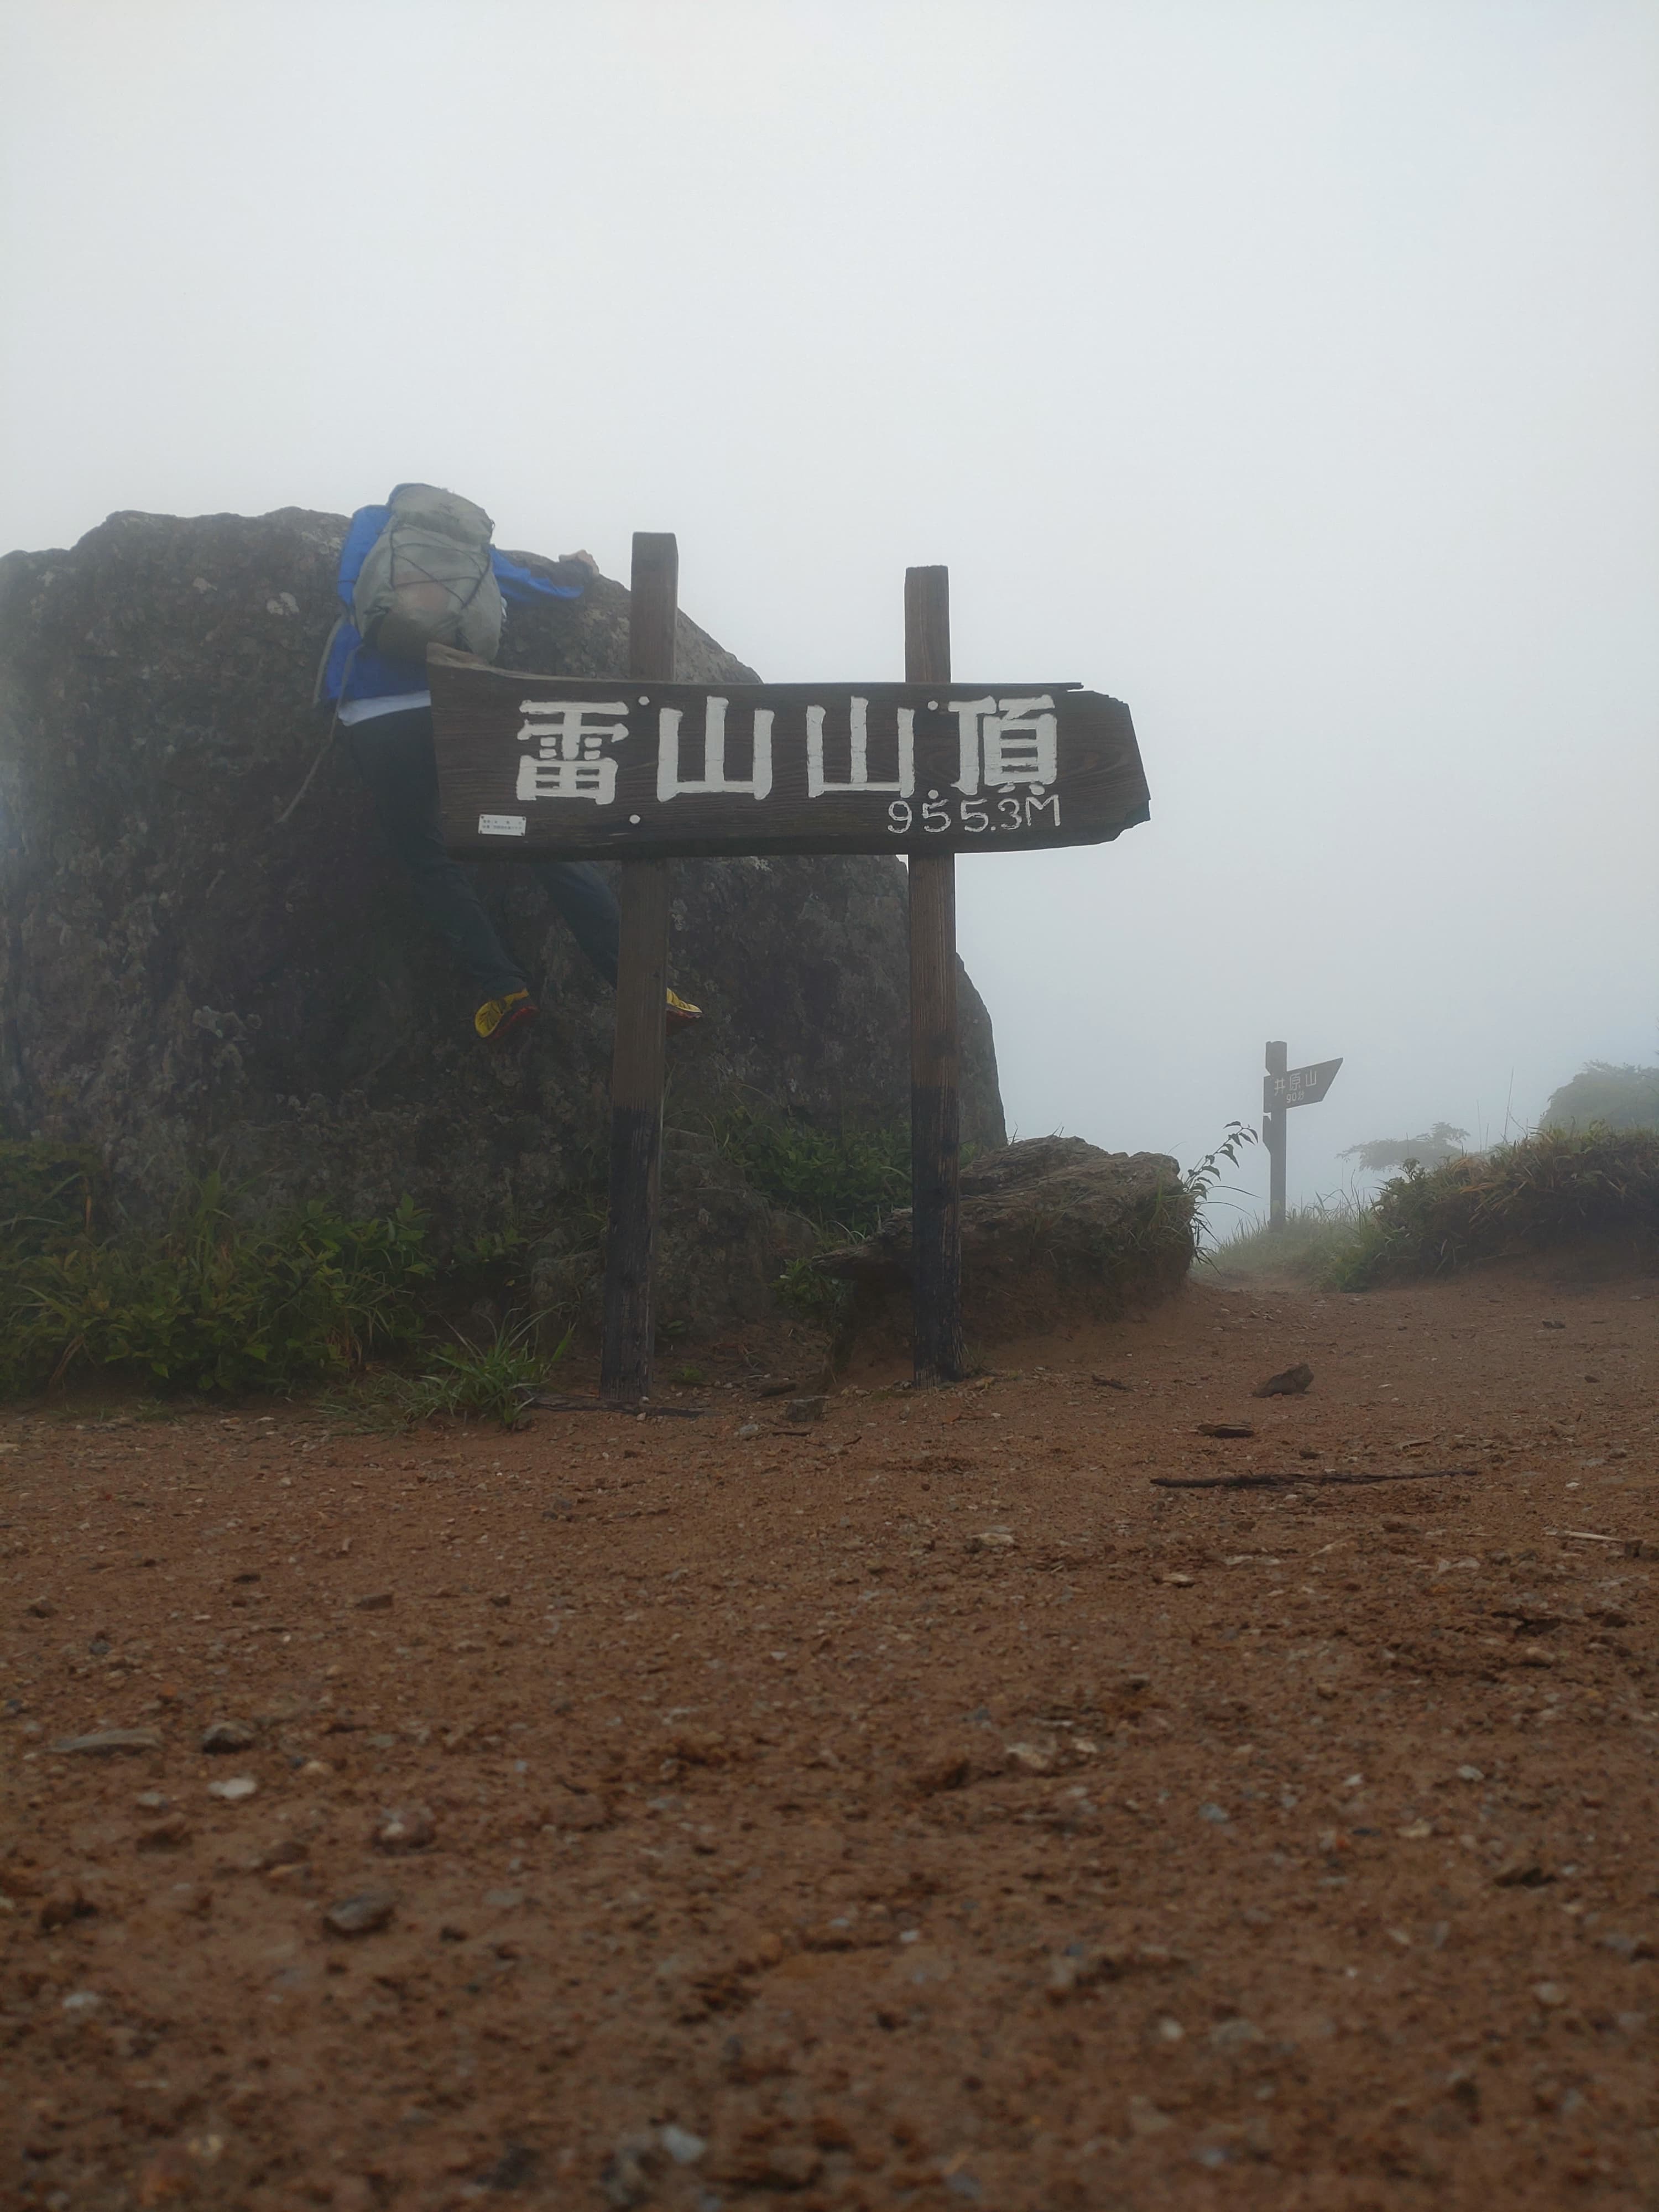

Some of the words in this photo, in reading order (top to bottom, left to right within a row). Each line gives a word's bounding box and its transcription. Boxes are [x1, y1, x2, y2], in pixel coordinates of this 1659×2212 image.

[517, 695, 1058, 805] 雷山山頂
[886, 796, 1062, 834] 955.3M
[1274, 1070, 1318, 1097] 井原山
[1286, 1091, 1305, 1103] 90分
